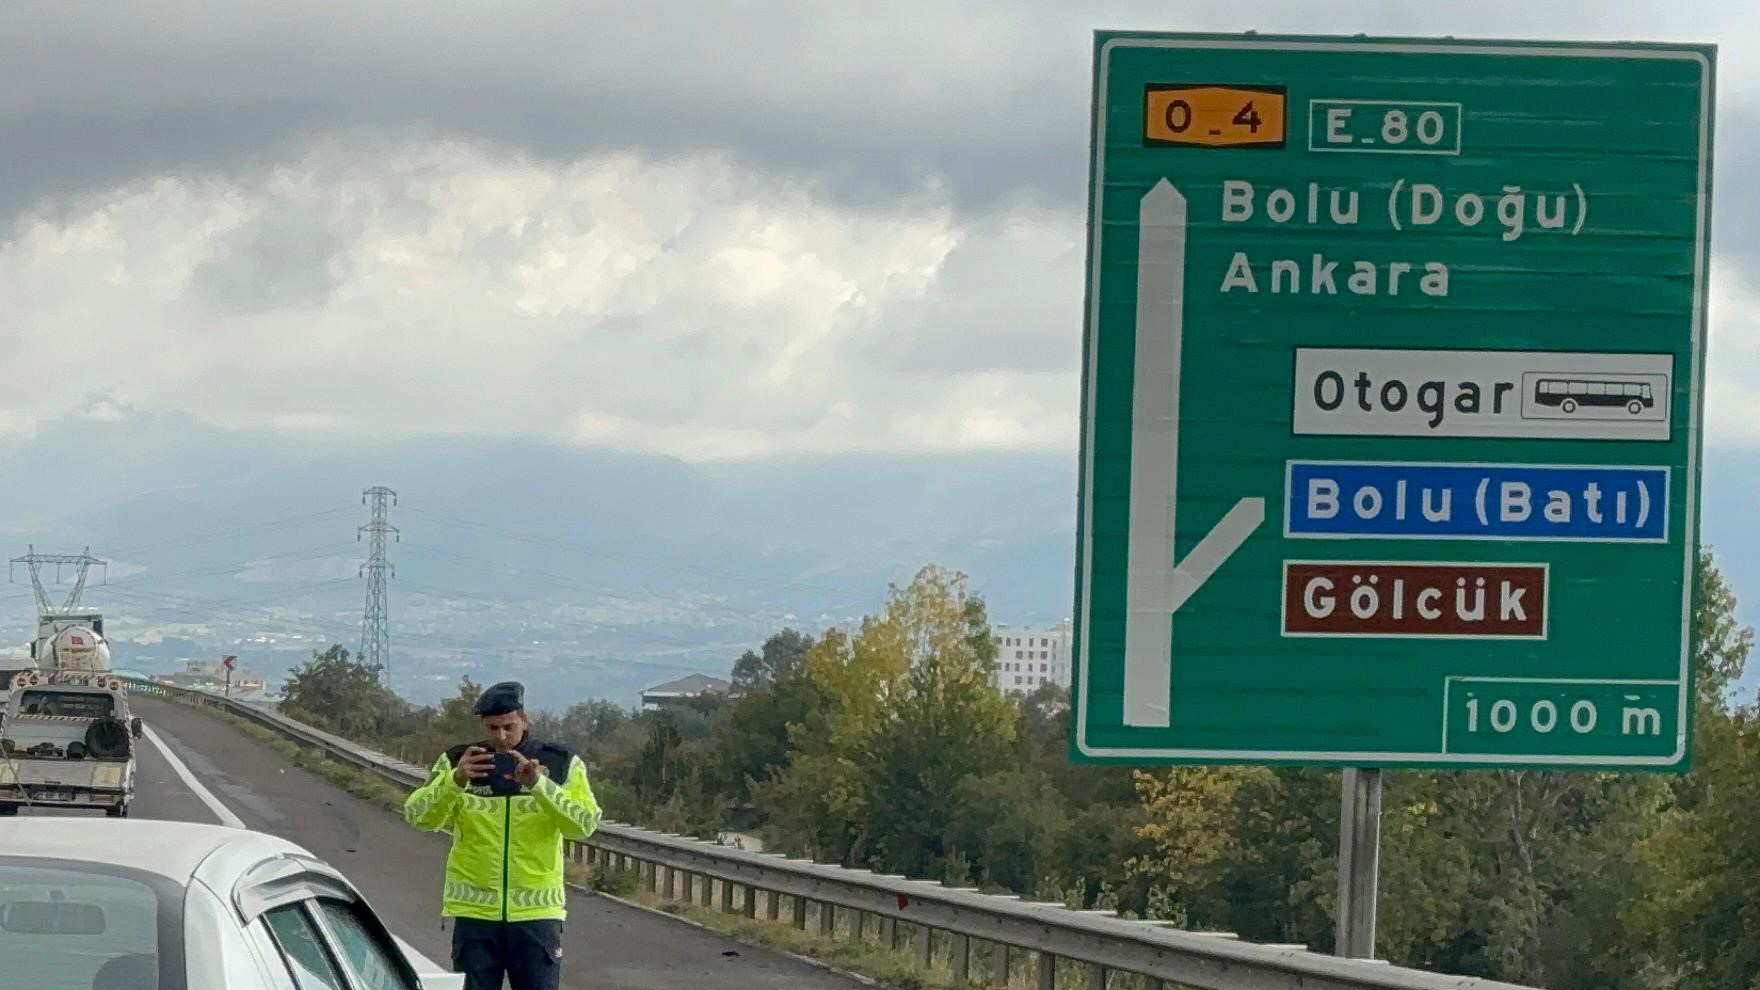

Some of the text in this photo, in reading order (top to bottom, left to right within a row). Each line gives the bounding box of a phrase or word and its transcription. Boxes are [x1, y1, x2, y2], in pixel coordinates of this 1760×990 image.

[1222, 178, 1588, 241] Bolu (Doğu)
[1220, 252, 1451, 297] Ankara
[1313, 370, 1515, 427] Otogar
[1306, 477, 1651, 527] Bolu (Batı)
[1303, 574, 1528, 622] Gölcük
[1465, 698, 1661, 737] 1000 m
